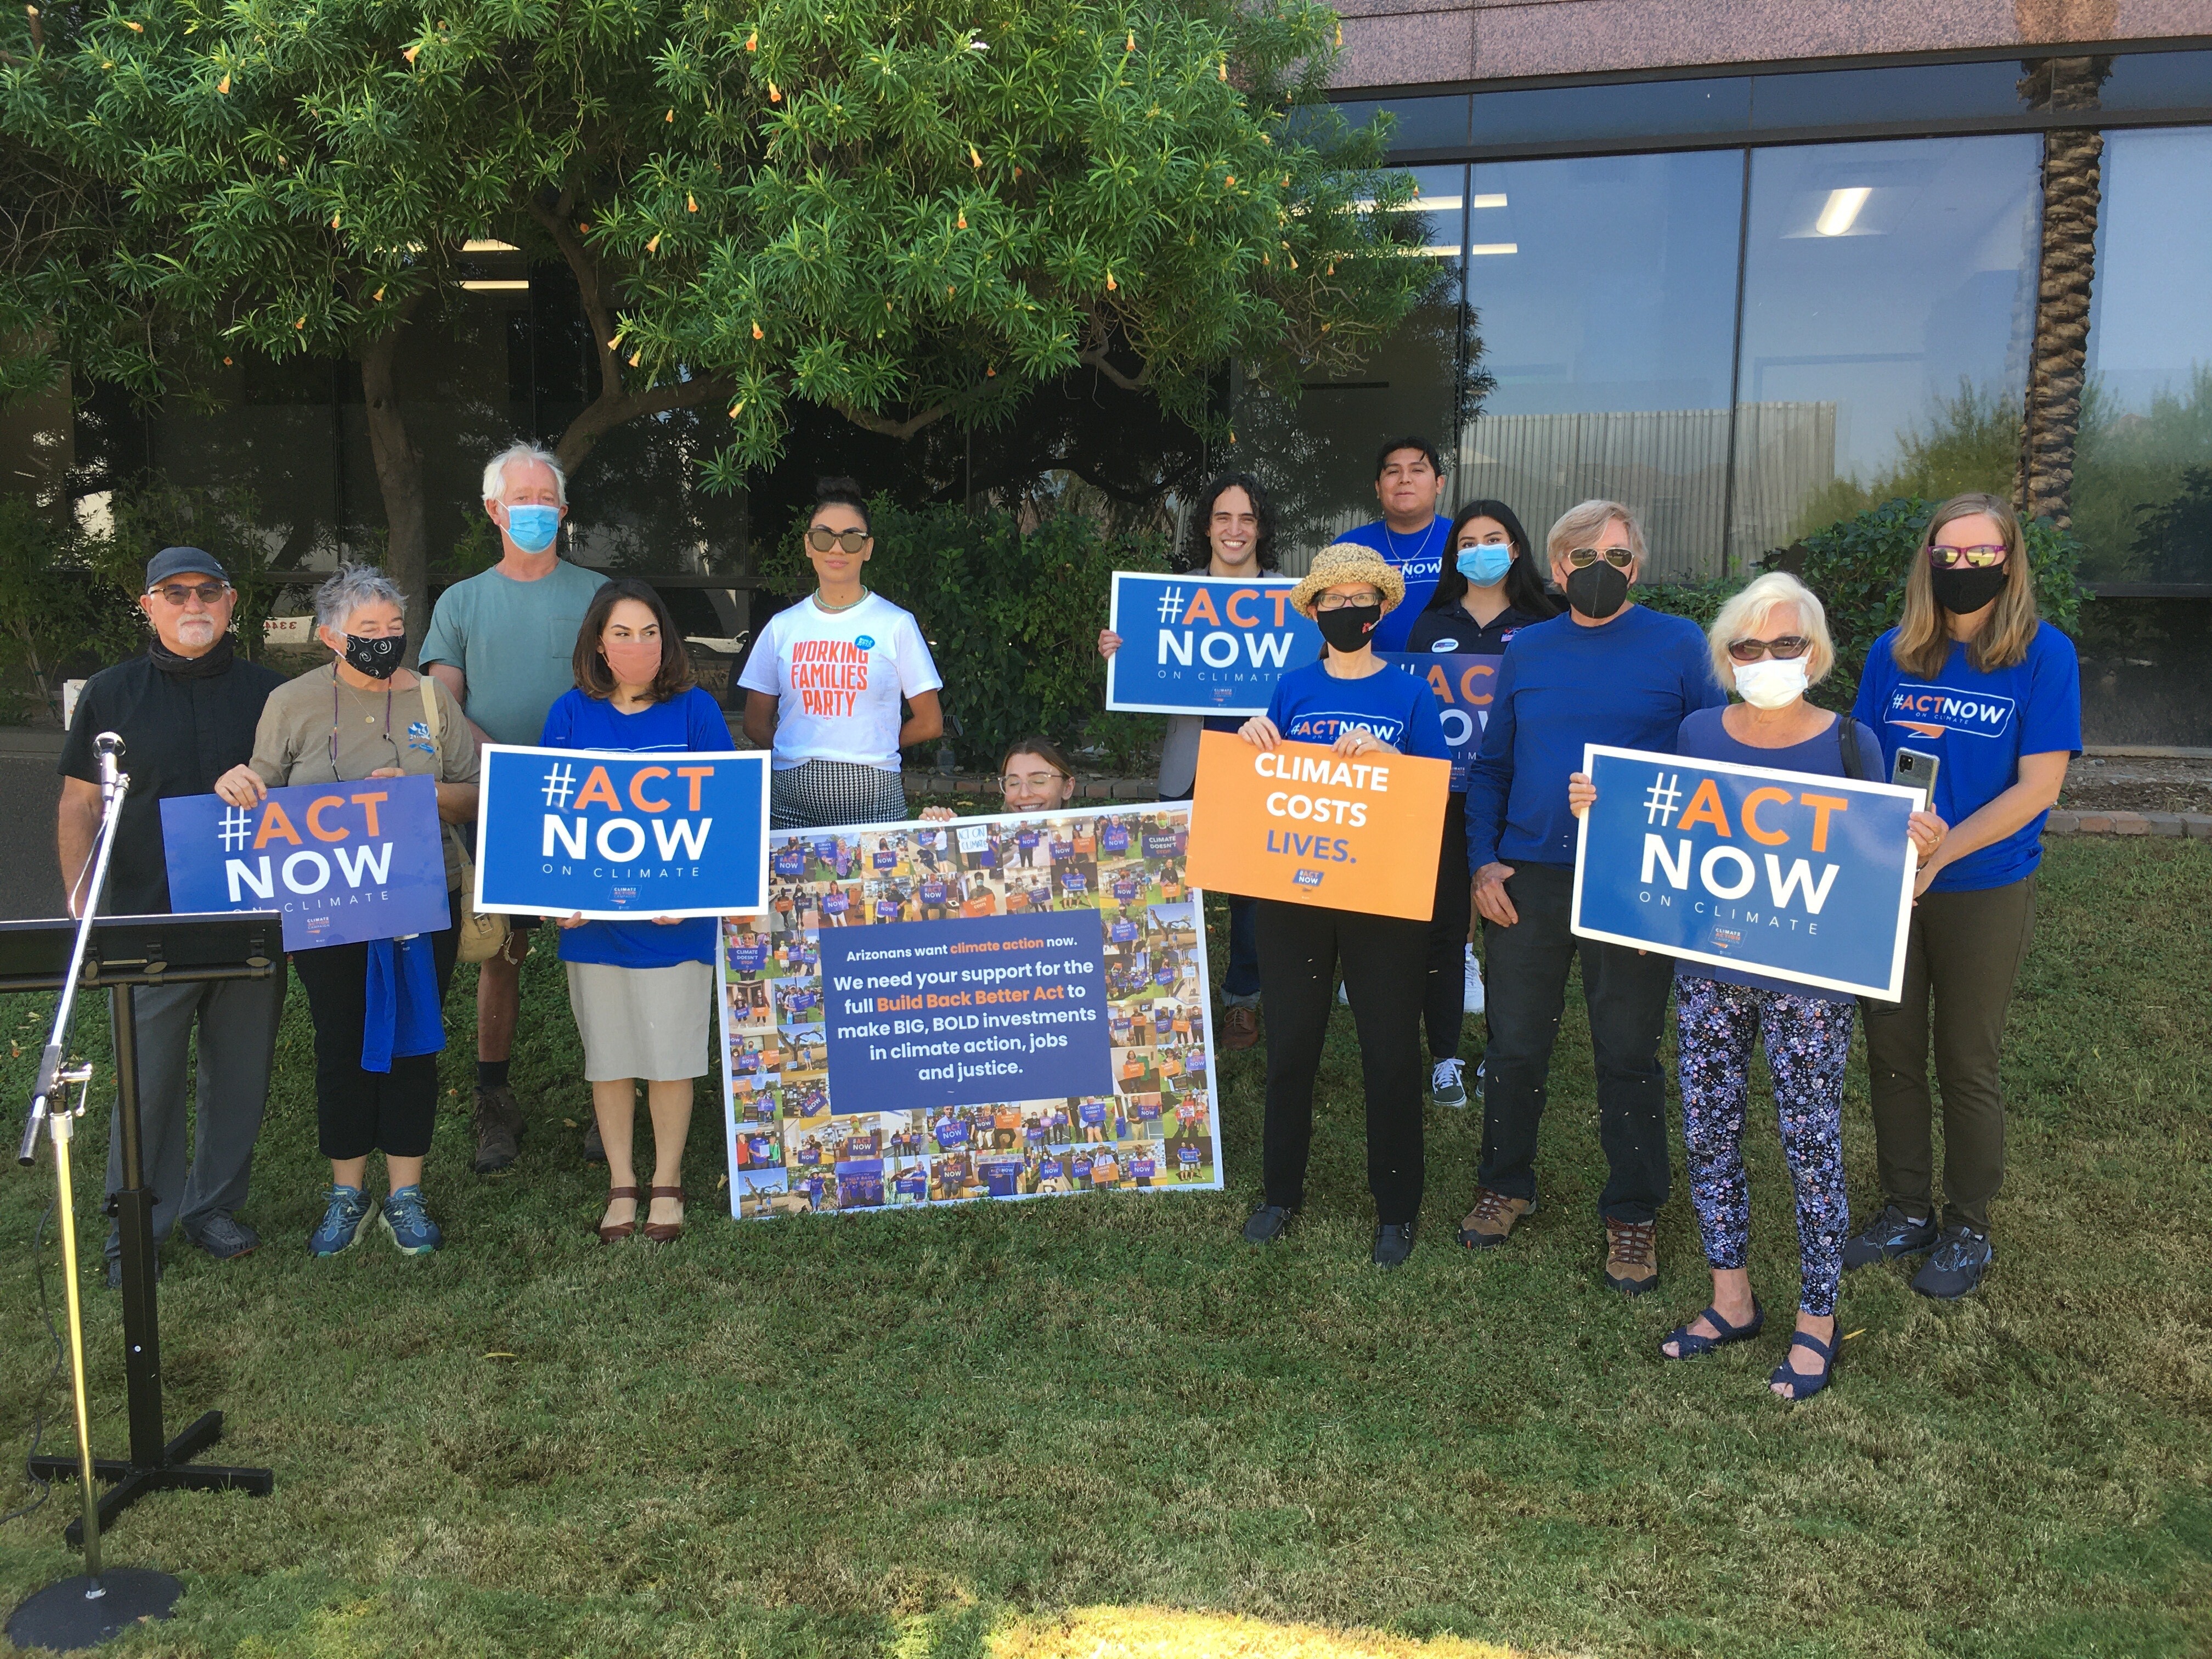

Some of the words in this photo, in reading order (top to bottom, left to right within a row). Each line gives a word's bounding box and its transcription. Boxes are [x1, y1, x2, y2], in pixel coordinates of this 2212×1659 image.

[1157, 586, 1291, 628] #ACT
[792, 641, 869, 664] WORKING
[1158, 629, 1294, 668] NOW
[791, 664, 868, 690] FAMILIES
[1158, 670, 1181, 679] ON
[802, 690, 857, 717] PARTY
[1892, 694, 2006, 724] #ACTNOW
[1934, 714, 1968, 724] CLIMATE
[1255, 752, 1389, 792] CLIMATE
[541, 763, 714, 812] #ACT
[218, 792, 388, 852] #ACT
[1266, 792, 1368, 827] COSTS
[1644, 772, 1848, 852] #ACT
[543, 814, 713, 862] NOW
[972, 827, 985, 838] ON
[1266, 830, 1357, 864] LIVES.
[225, 842, 393, 902] NOW
[543, 864, 572, 875] ON
[594, 867, 699, 878] CLIMATE
[1641, 833, 1839, 915] NOW
[285, 891, 388, 912] CLIMATE
[1640, 891, 1671, 906] ON
[1695, 902, 1818, 935] CLIMATE
[1716, 928, 1741, 936] CLIMATE
[847, 949, 912, 961] Arizonans
[915, 945, 948, 956] want
[950, 941, 1000, 953] climate
[1003, 938, 1043, 950] action
[1047, 937, 1077, 947] now.
[833, 976, 863, 991] We
[867, 971, 912, 989] need
[916, 970, 958, 990] your
[962, 963, 1032, 985] support
[1036, 961, 1060, 977] for
[1064, 960, 1093, 974] the
[845, 998, 873, 1014] full
[877, 994, 923, 1012] Build
[927, 991, 972, 1008] Back
[975, 989, 1030, 1005] Better
[1034, 985, 1064, 1001] Act
[1067, 984, 1086, 998] to
[838, 1022, 890, 1039] make
[894, 1019, 929, 1035] BIG,
[933, 1015, 979, 1031] BOLD
[983, 1008, 1096, 1028] investments
[870, 1045, 887, 1060] in
[890, 1041, 960, 1058] climate
[963, 1036, 1026, 1053] action,
[1030, 1032, 1068, 1053] jobs
[918, 1064, 954, 1080] and
[957, 1059, 1023, 1082] justice.
[807, 1097, 821, 1111] NOW
[943, 1130, 962, 1139] NOW
